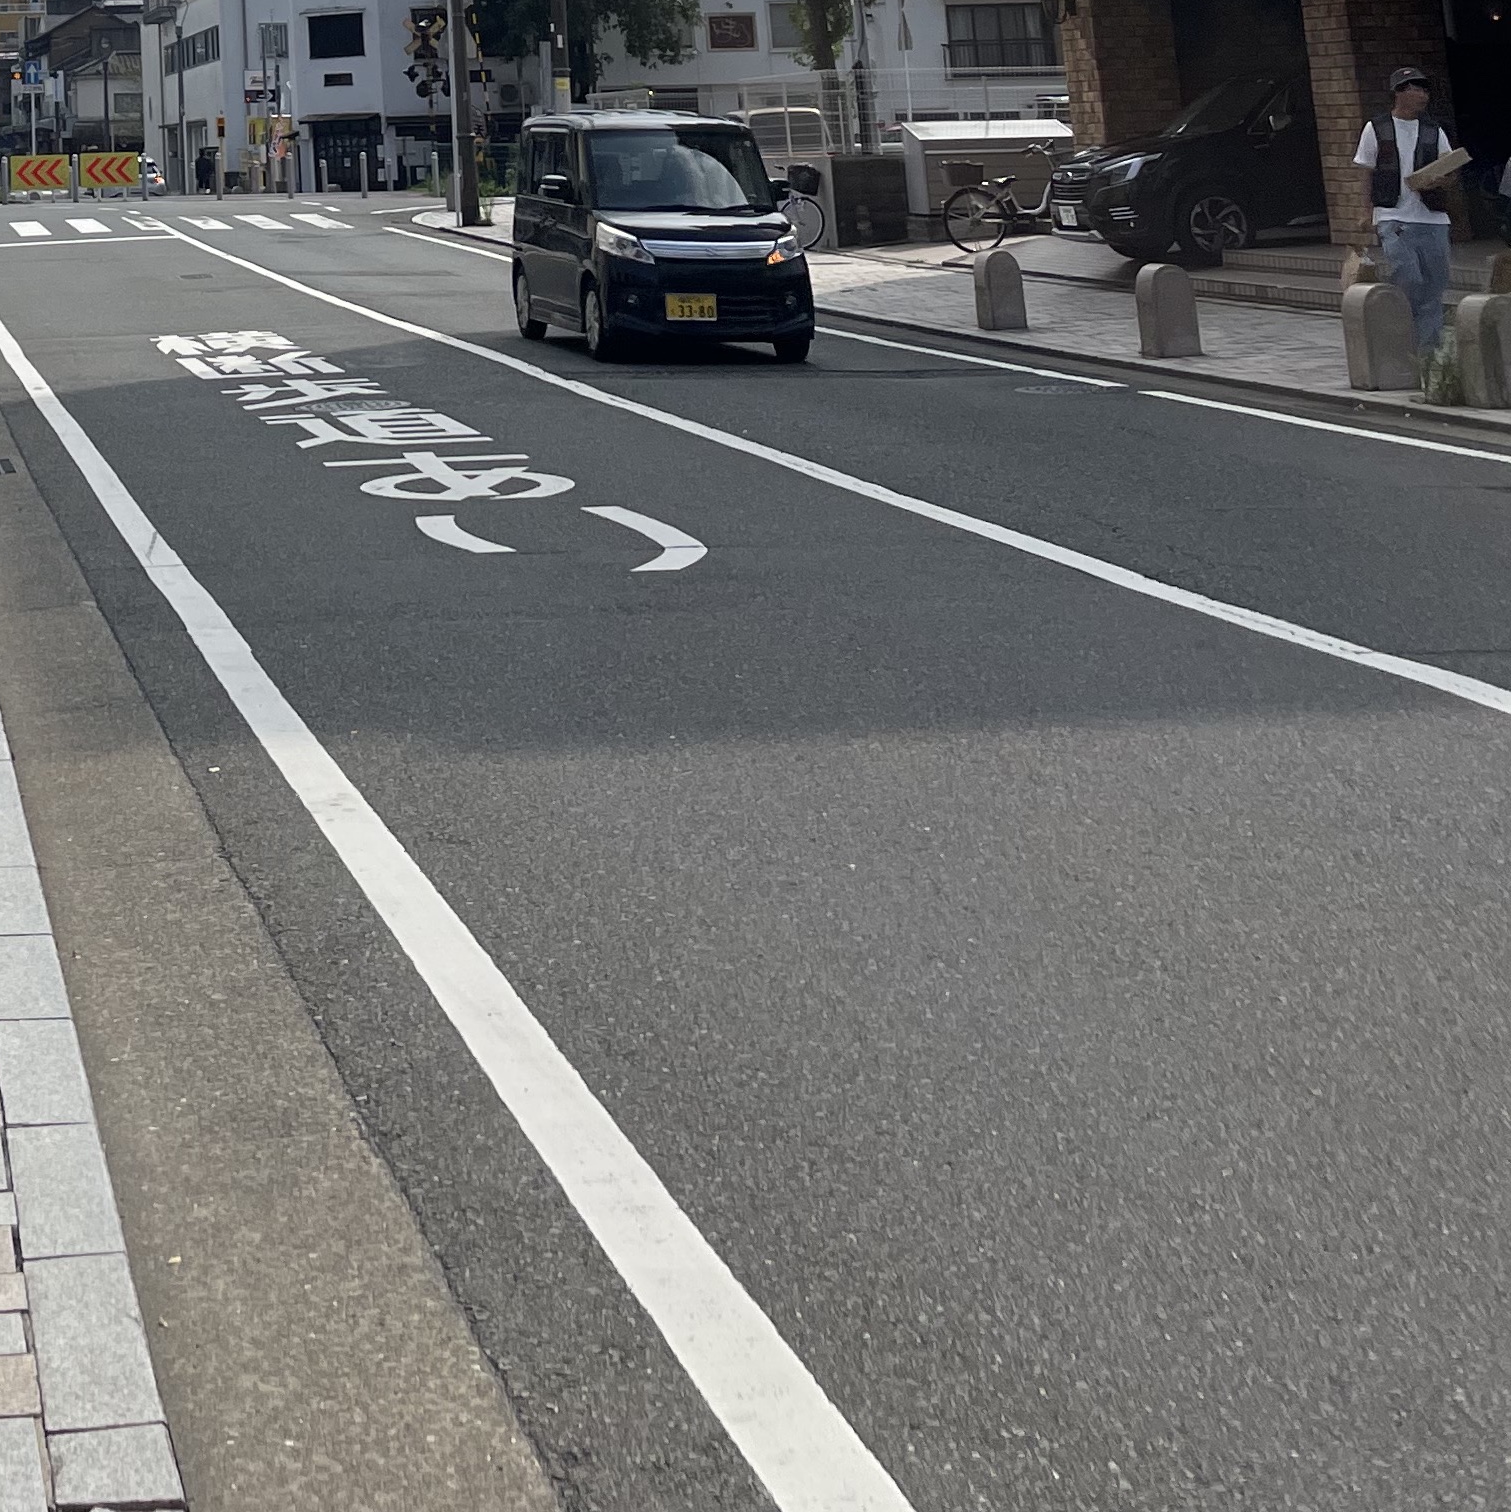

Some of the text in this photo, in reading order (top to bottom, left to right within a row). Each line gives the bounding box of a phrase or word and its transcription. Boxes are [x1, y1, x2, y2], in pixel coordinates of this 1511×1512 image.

[149, 330, 709, 572] 横断歩道あり
